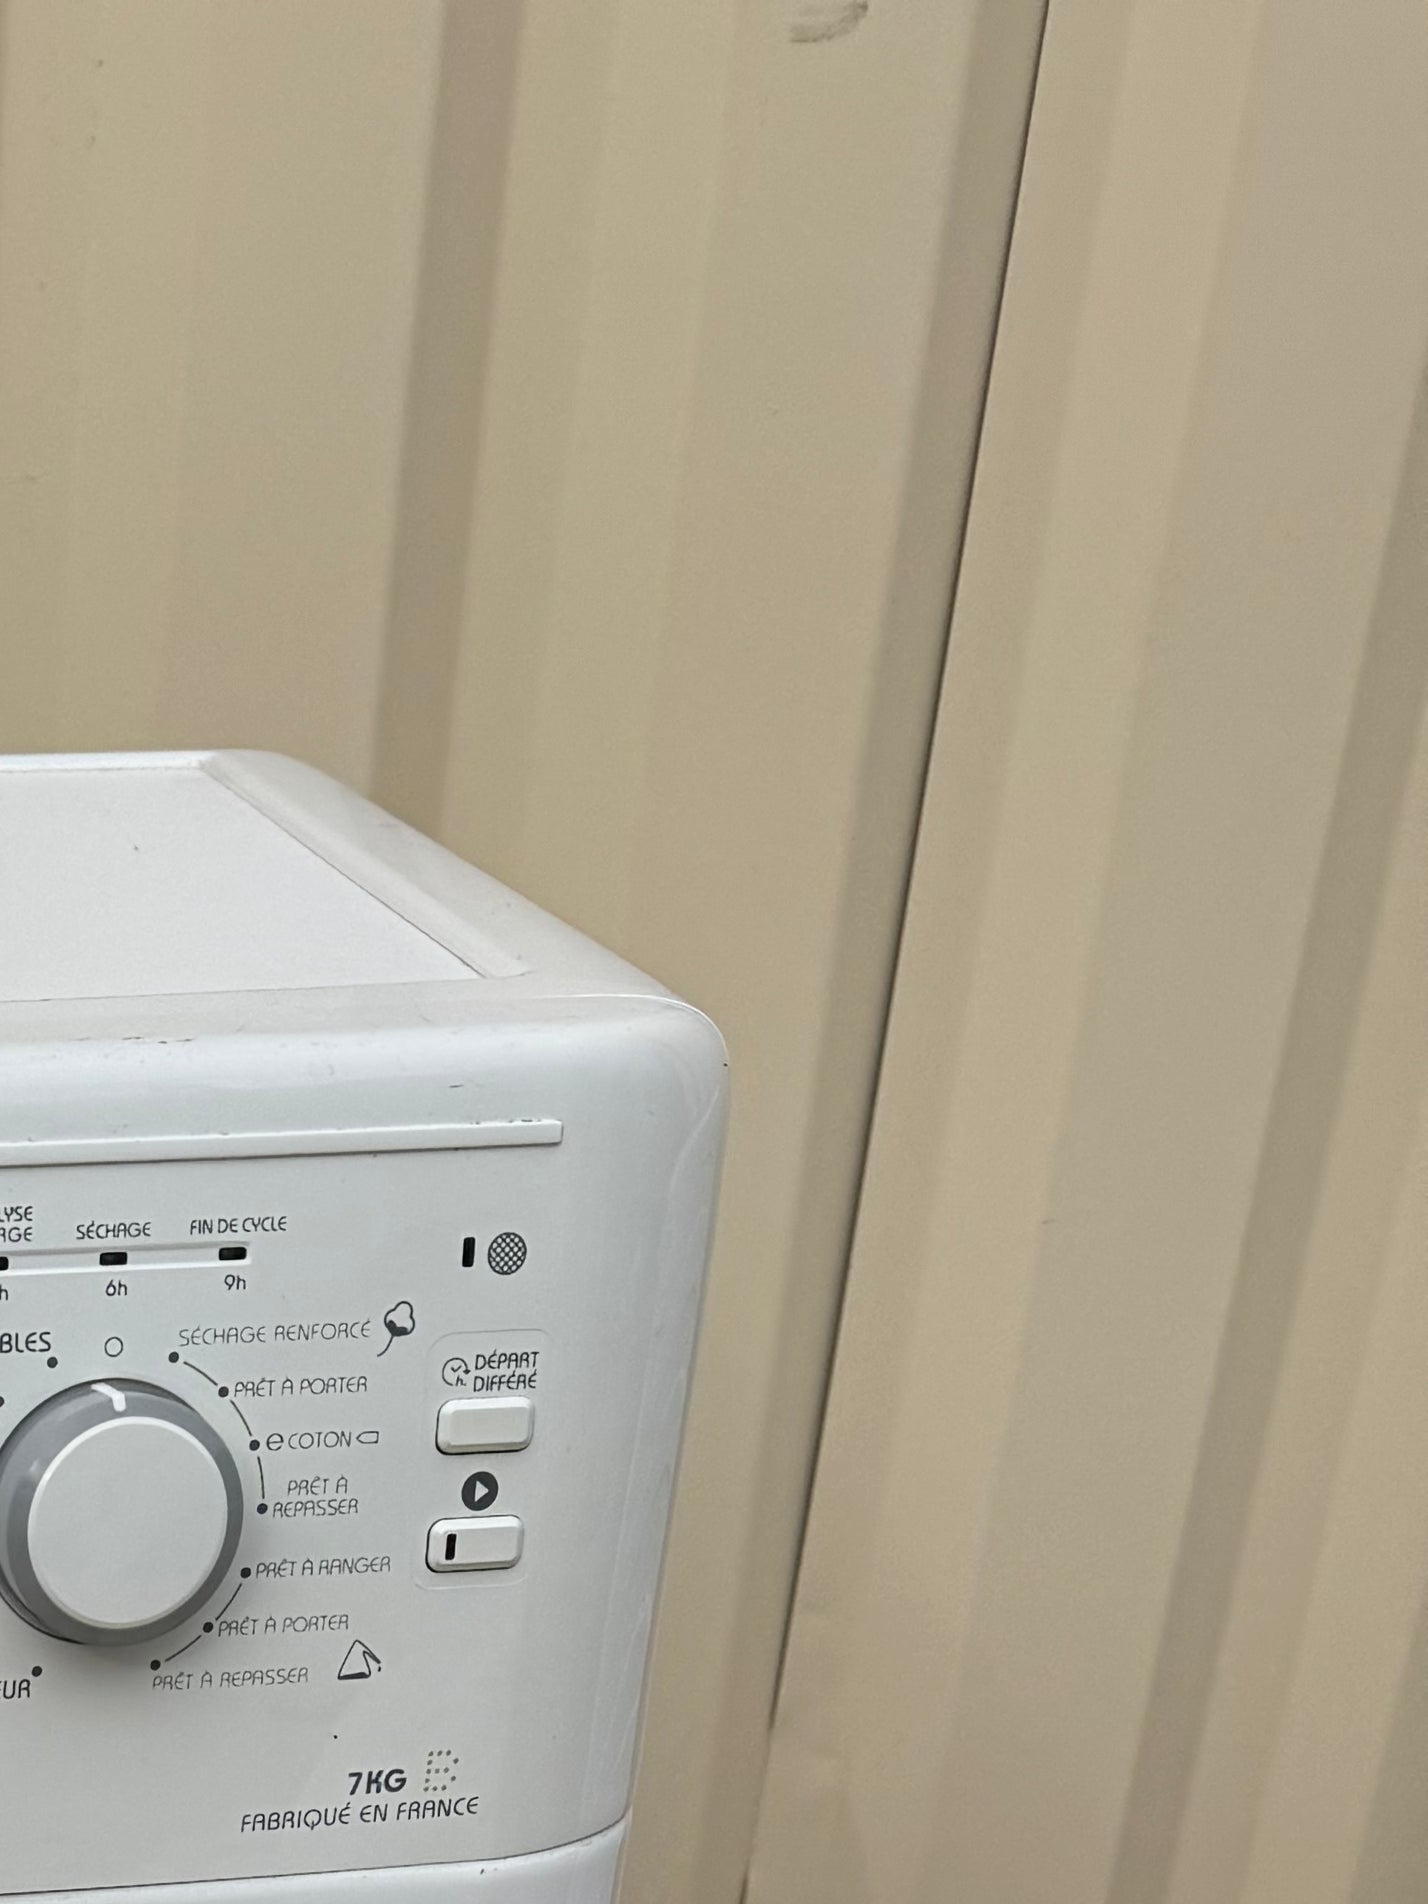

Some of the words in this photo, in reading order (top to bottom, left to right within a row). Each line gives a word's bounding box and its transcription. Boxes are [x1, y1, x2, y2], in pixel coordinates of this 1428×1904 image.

[76, 1220, 152, 1240] SÉCHAGE
[189, 1219, 216, 1236] FIN
[217, 1217, 239, 1234] DE
[240, 1215, 288, 1234] CYCLE
[105, 1280, 128, 1298] 6h
[224, 1273, 247, 1292] 9h
[178, 1325, 266, 1347] SÉCHAGE
[274, 1319, 372, 1342] RENFORCÉ
[474, 1350, 540, 1371] DÉPART
[234, 1377, 276, 1398] PRÊT
[281, 1375, 295, 1395] À
[300, 1375, 369, 1395] PORTER
[473, 1371, 538, 1393] DIFFÉRÉ
[288, 1429, 354, 1450] COTON
[287, 1477, 330, 1496] PRÊT
[335, 1475, 349, 1493] À
[272, 1498, 360, 1519] REPASSER
[255, 1559, 297, 1580] PRÊT
[301, 1558, 314, 1577] À
[318, 1556, 392, 1577] RANGER
[217, 1616, 260, 1637] PRÊT
[264, 1616, 277, 1634] À
[282, 1614, 350, 1633] PORTER
[152, 1670, 193, 1691] PRÊT
[200, 1669, 214, 1688] À
[219, 1666, 310, 1688] REPASSER
[347, 1768, 408, 1796] 7KG
[240, 1802, 351, 1833] FABRIQUÉ
[359, 1804, 388, 1823] EN
[396, 1796, 480, 1820] FRANCE
